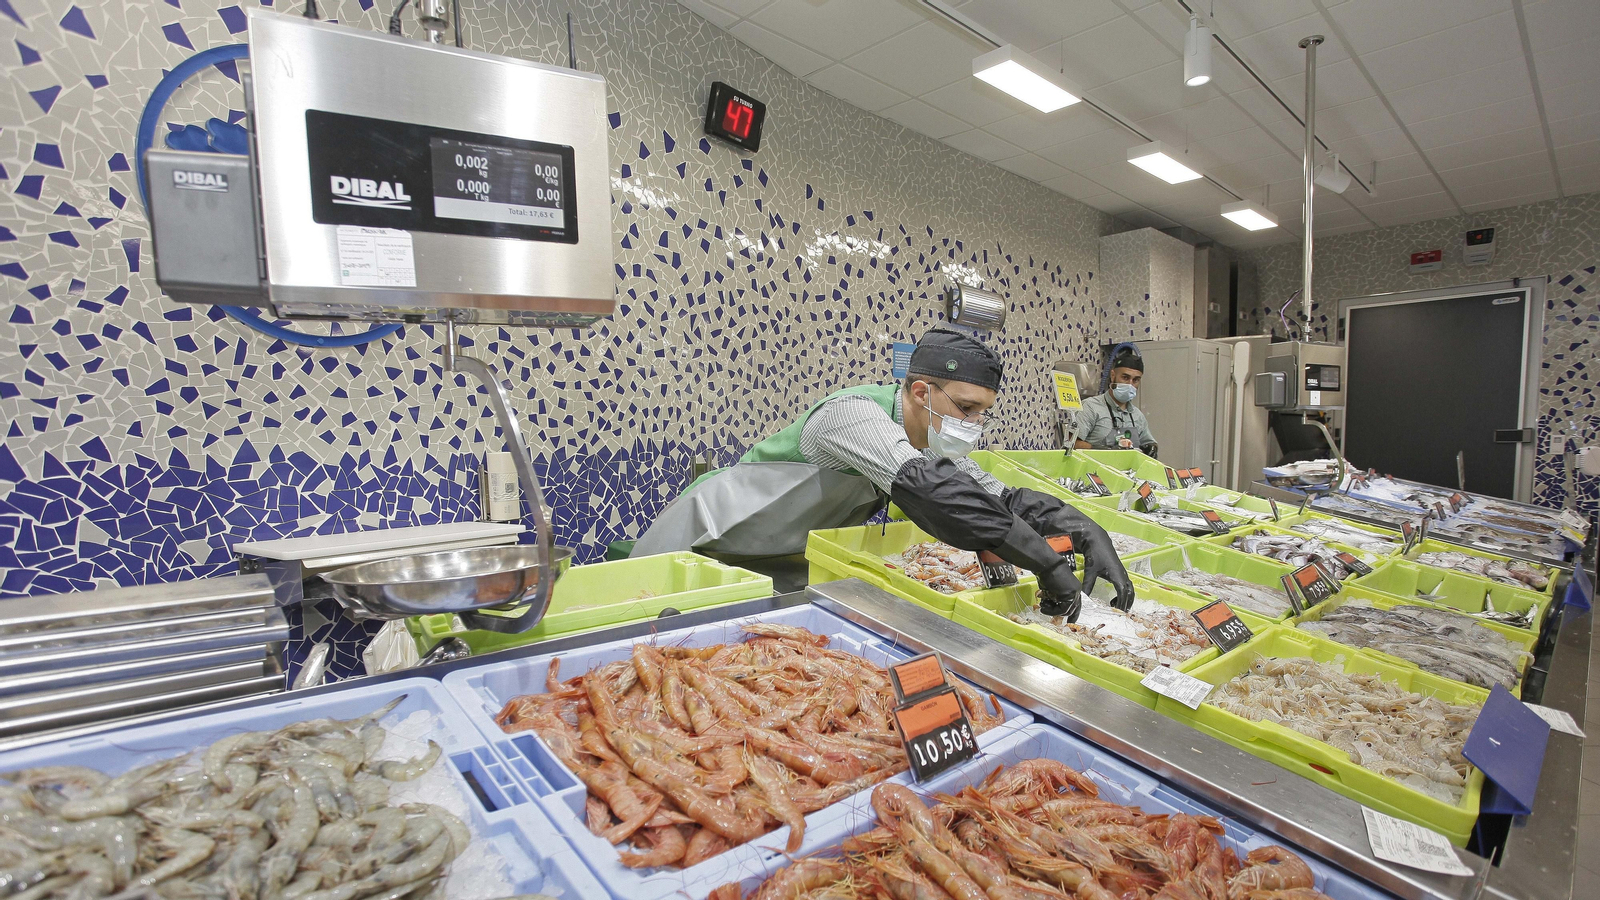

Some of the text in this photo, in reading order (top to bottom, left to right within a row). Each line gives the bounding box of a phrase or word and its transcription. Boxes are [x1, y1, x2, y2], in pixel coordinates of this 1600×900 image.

[726, 99, 755, 139] 47
[455, 154, 488, 170] 0,002
[173, 170, 228, 187] DIBAL
[478, 169, 488, 179] kg
[535, 164, 559, 179] 0,00
[330, 175, 412, 202] DIBAL
[456, 179, 490, 194] 0,000
[536, 188, 560, 202] 0,00
[508, 208, 528, 217] Total:
[529, 210, 548, 219] 17,63
